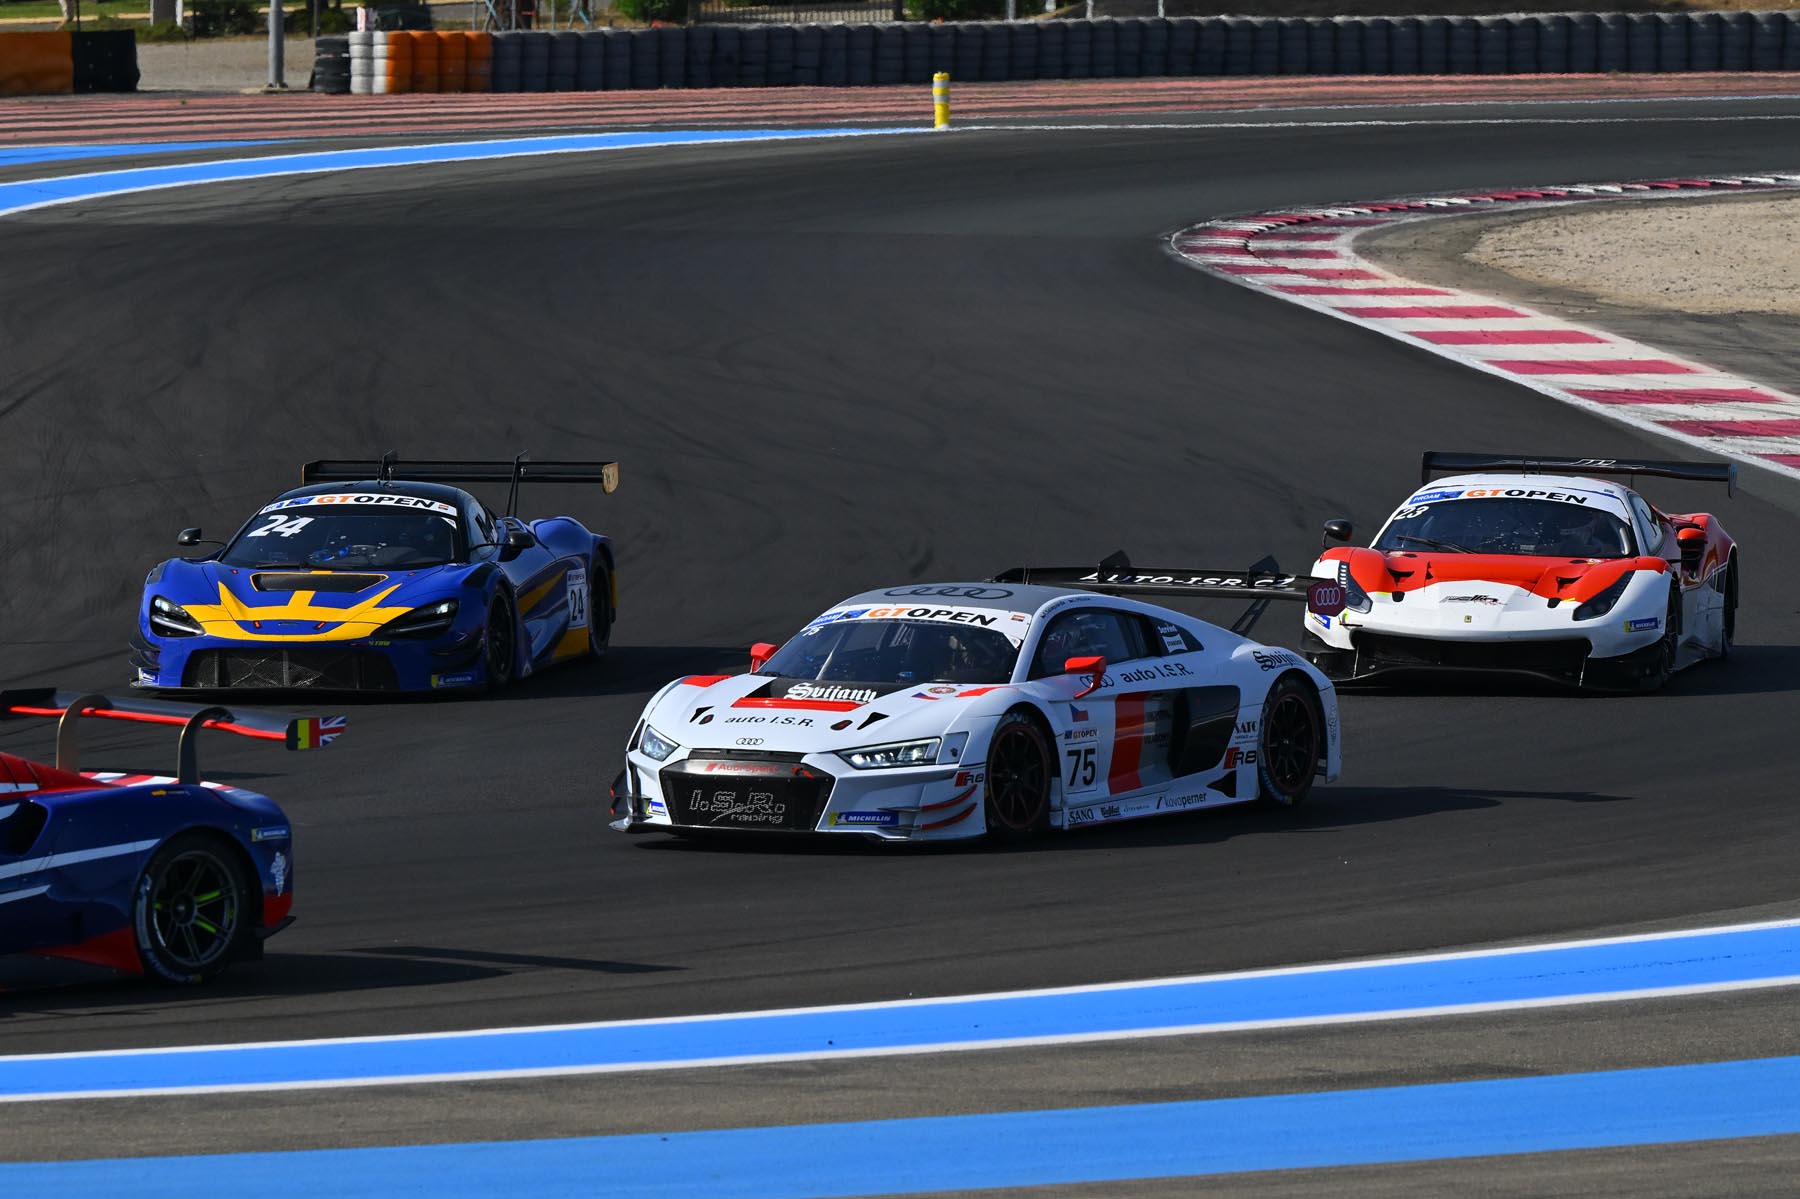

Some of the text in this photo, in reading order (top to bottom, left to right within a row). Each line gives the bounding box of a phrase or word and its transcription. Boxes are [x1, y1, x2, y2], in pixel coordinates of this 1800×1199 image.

[1393, 505, 1430, 520] 23
[247, 514, 316, 538] 24
[570, 588, 584, 621] 24
[1120, 663, 1194, 683] auto I.S.R.
[784, 682, 878, 703] Svijany
[725, 716, 814, 728] auto I.S.R.
[1066, 748, 1096, 787] 75
[1234, 750, 1257, 765] R8
[964, 773, 984, 784] R8
